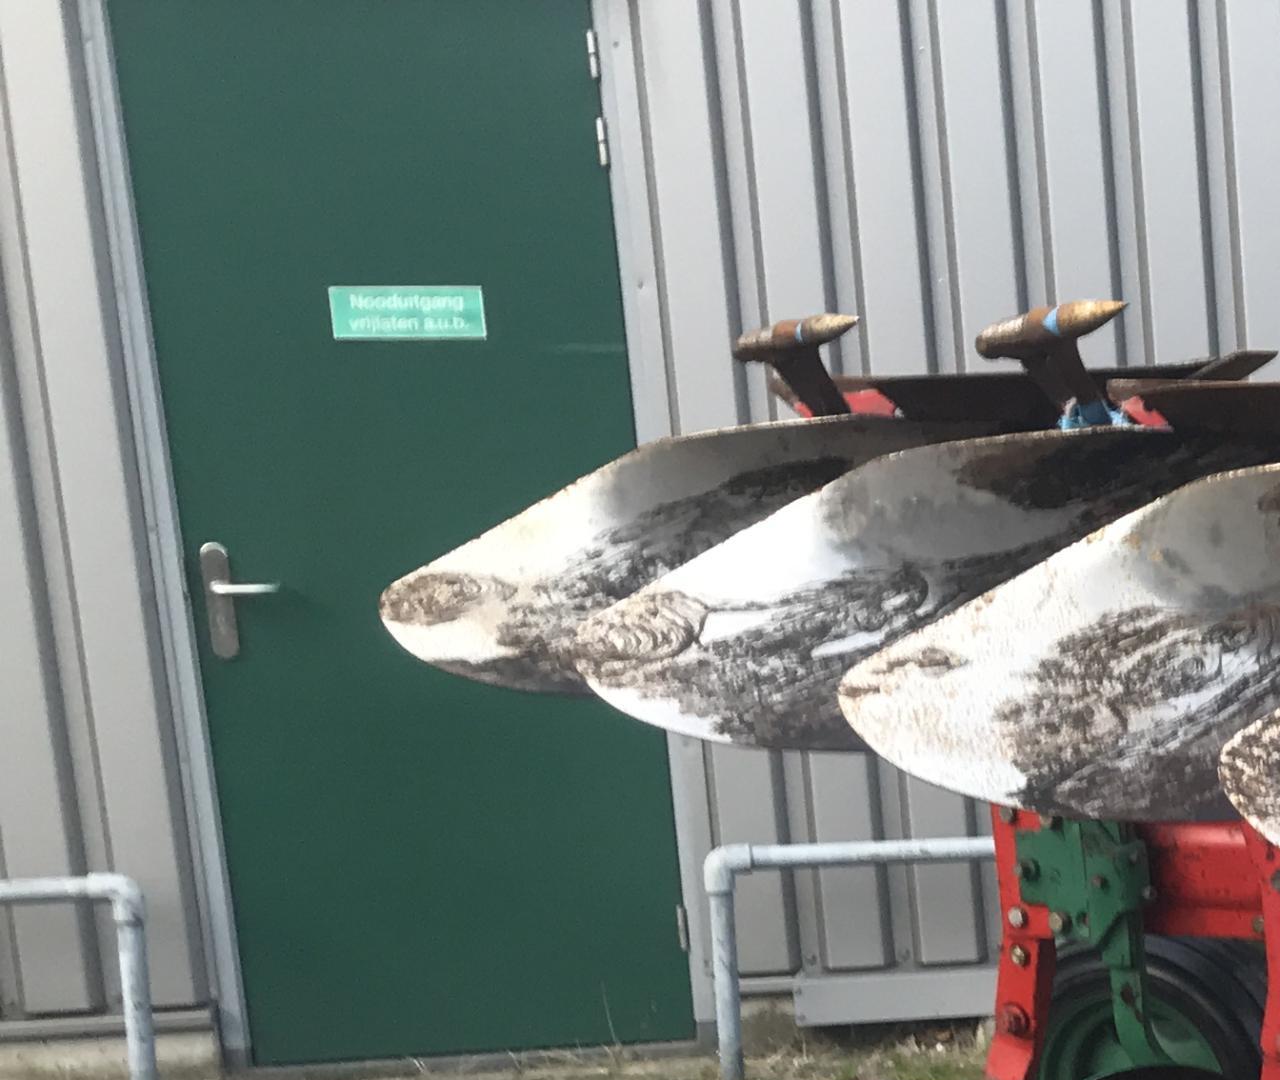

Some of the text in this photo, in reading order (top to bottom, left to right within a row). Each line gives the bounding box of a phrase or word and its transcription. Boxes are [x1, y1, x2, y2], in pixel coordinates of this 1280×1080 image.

[349, 294, 464, 312] Nooduitgang
[348, 316, 470, 332] vrijlaten a.u.b.
